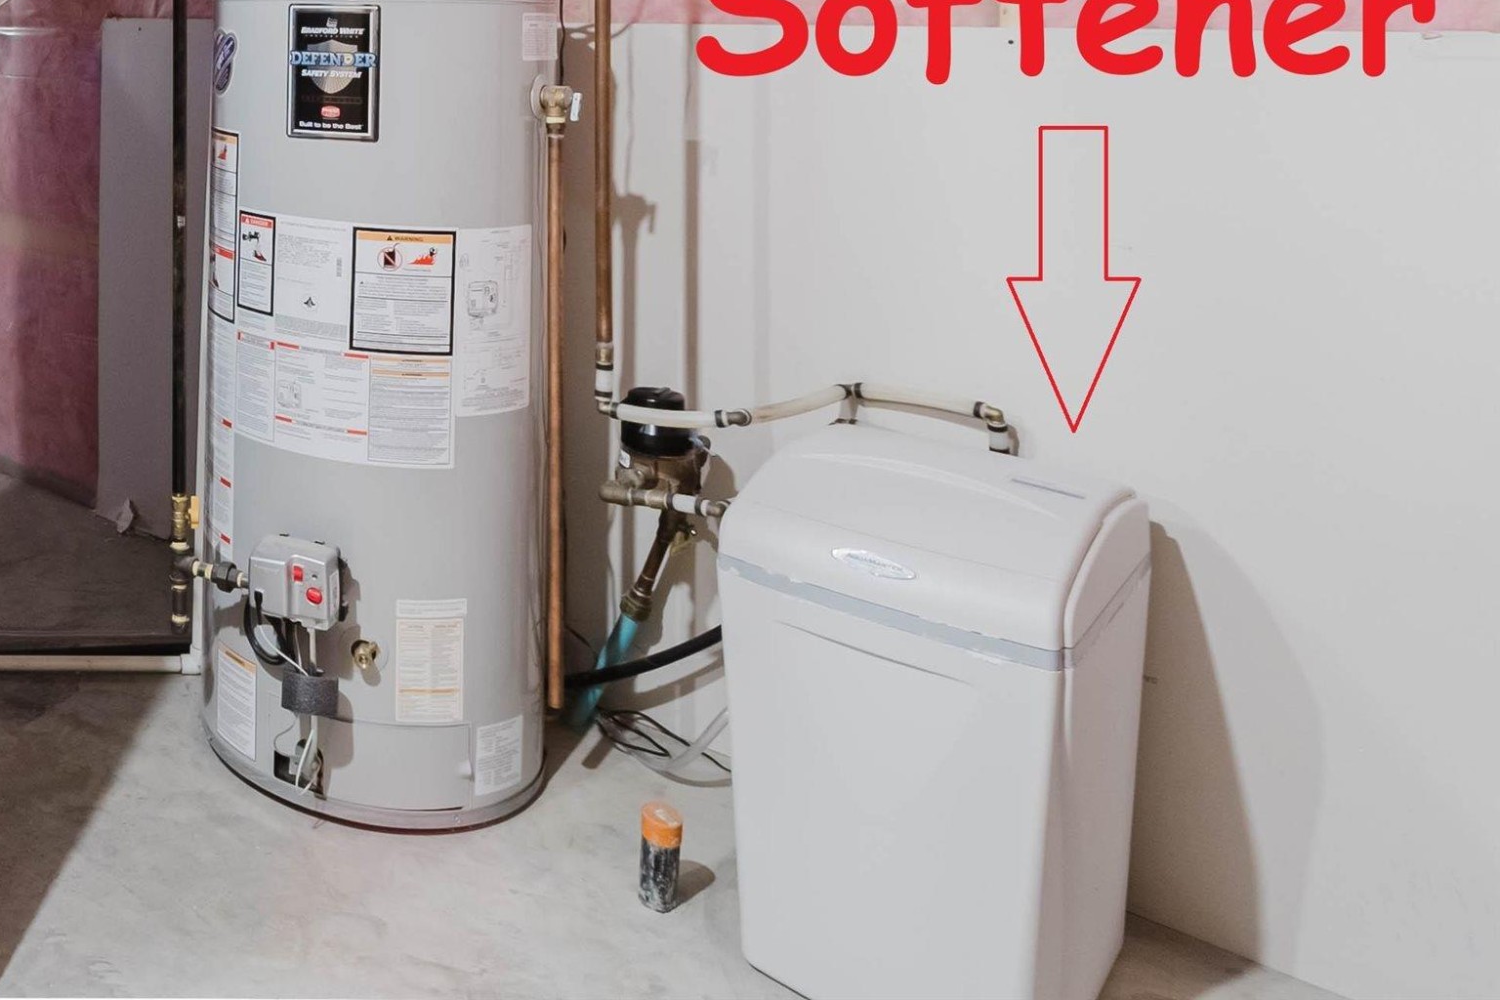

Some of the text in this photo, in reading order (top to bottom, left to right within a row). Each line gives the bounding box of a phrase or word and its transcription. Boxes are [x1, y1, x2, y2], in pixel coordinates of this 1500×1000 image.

[290, 51, 377, 68] DEFENDER
[301, 68, 362, 79] SAFETY SYSTEM
